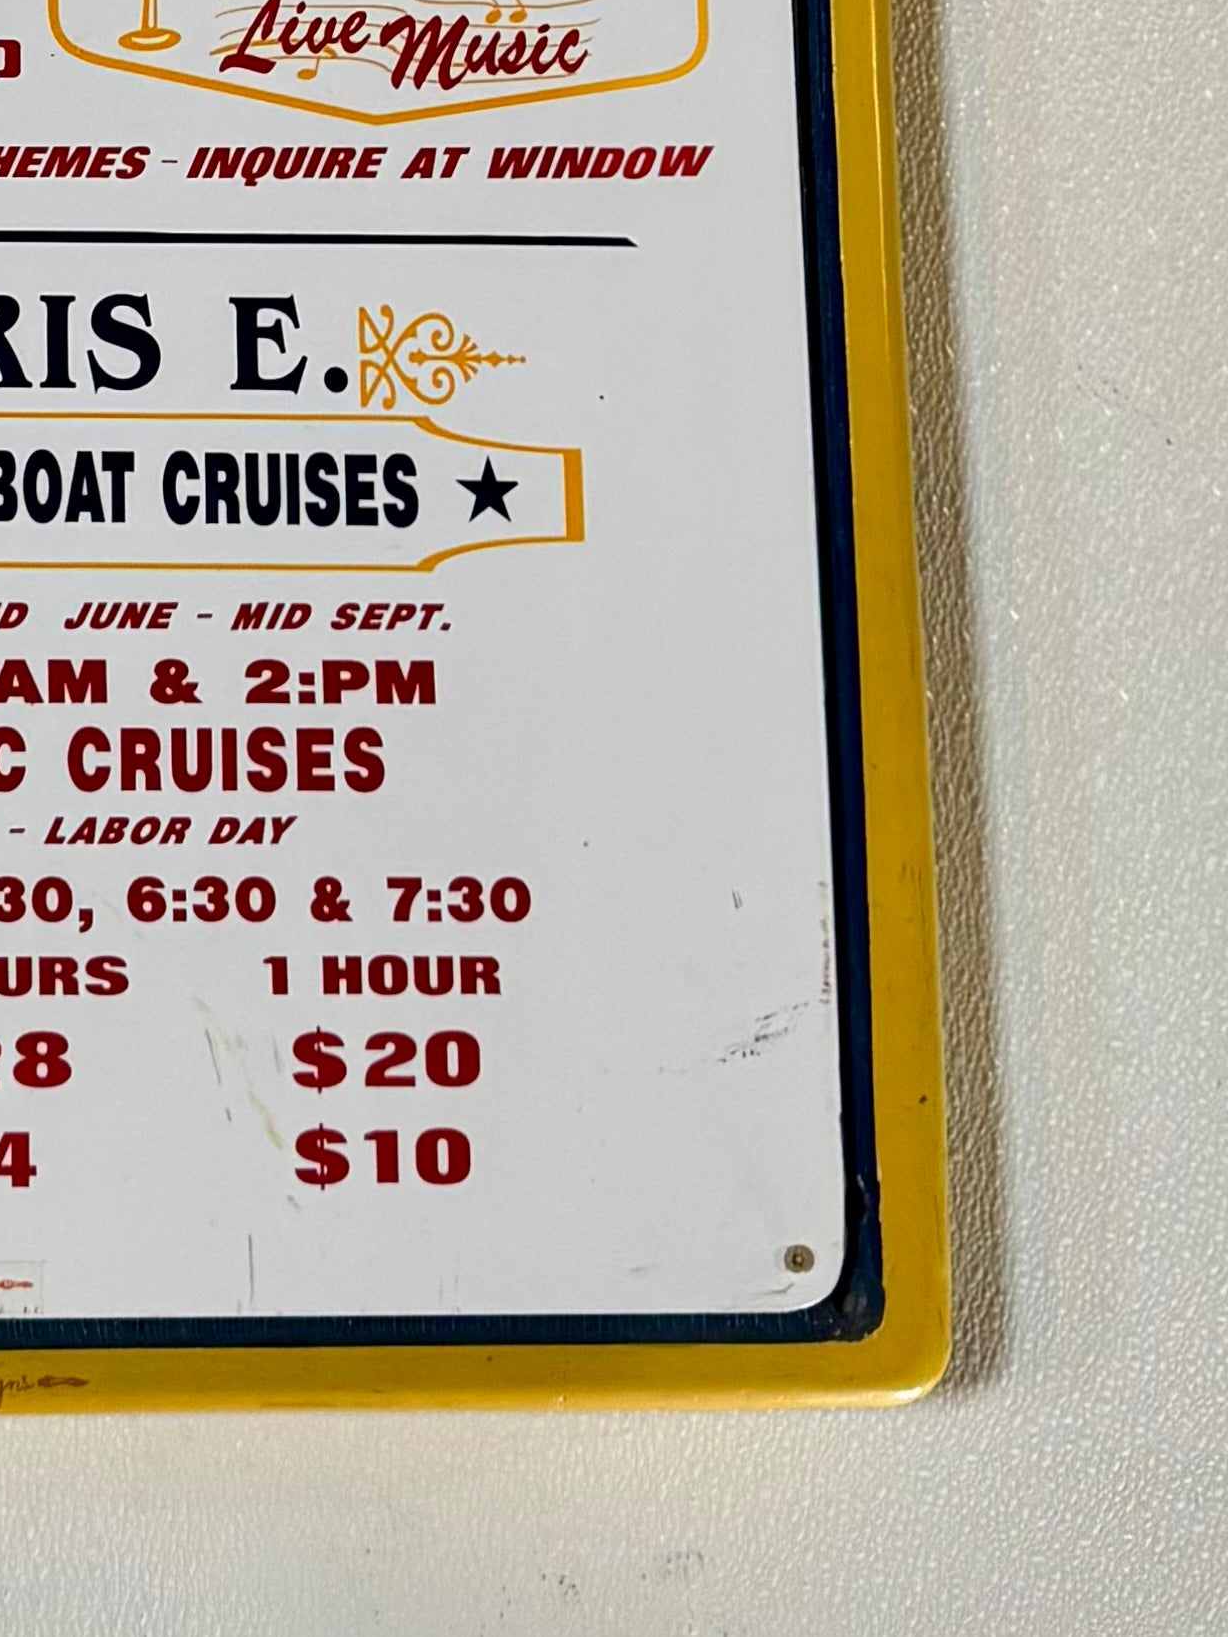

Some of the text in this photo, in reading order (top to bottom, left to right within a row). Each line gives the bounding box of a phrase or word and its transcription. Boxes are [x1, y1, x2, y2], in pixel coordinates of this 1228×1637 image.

[379, 15, 588, 90] Music
[188, 147, 386, 186] INQUIRE
[401, 148, 472, 178] AT
[497, 146, 714, 179] WINDOW
[229, 295, 348, 394] E.
[163, 451, 418, 528] CRUISES
[64, 602, 178, 631] JUNE
[231, 603, 312, 631] MID
[330, 603, 453, 631] SEPT.
[150, 659, 202, 704] &
[245, 659, 436, 705] 2:PM
[68, 727, 386, 793] CRUISES
[44, 816, 192, 845] LABOR
[209, 815, 297, 844] DAY
[126, 877, 276, 924] 6:30
[310, 877, 353, 922] &
[386, 877, 532, 923] 7:30
[263, 956, 288, 995] 1
[322, 955, 501, 996] HOUR
[292, 1026, 481, 1092] $20
[294, 1124, 472, 1190] $10
